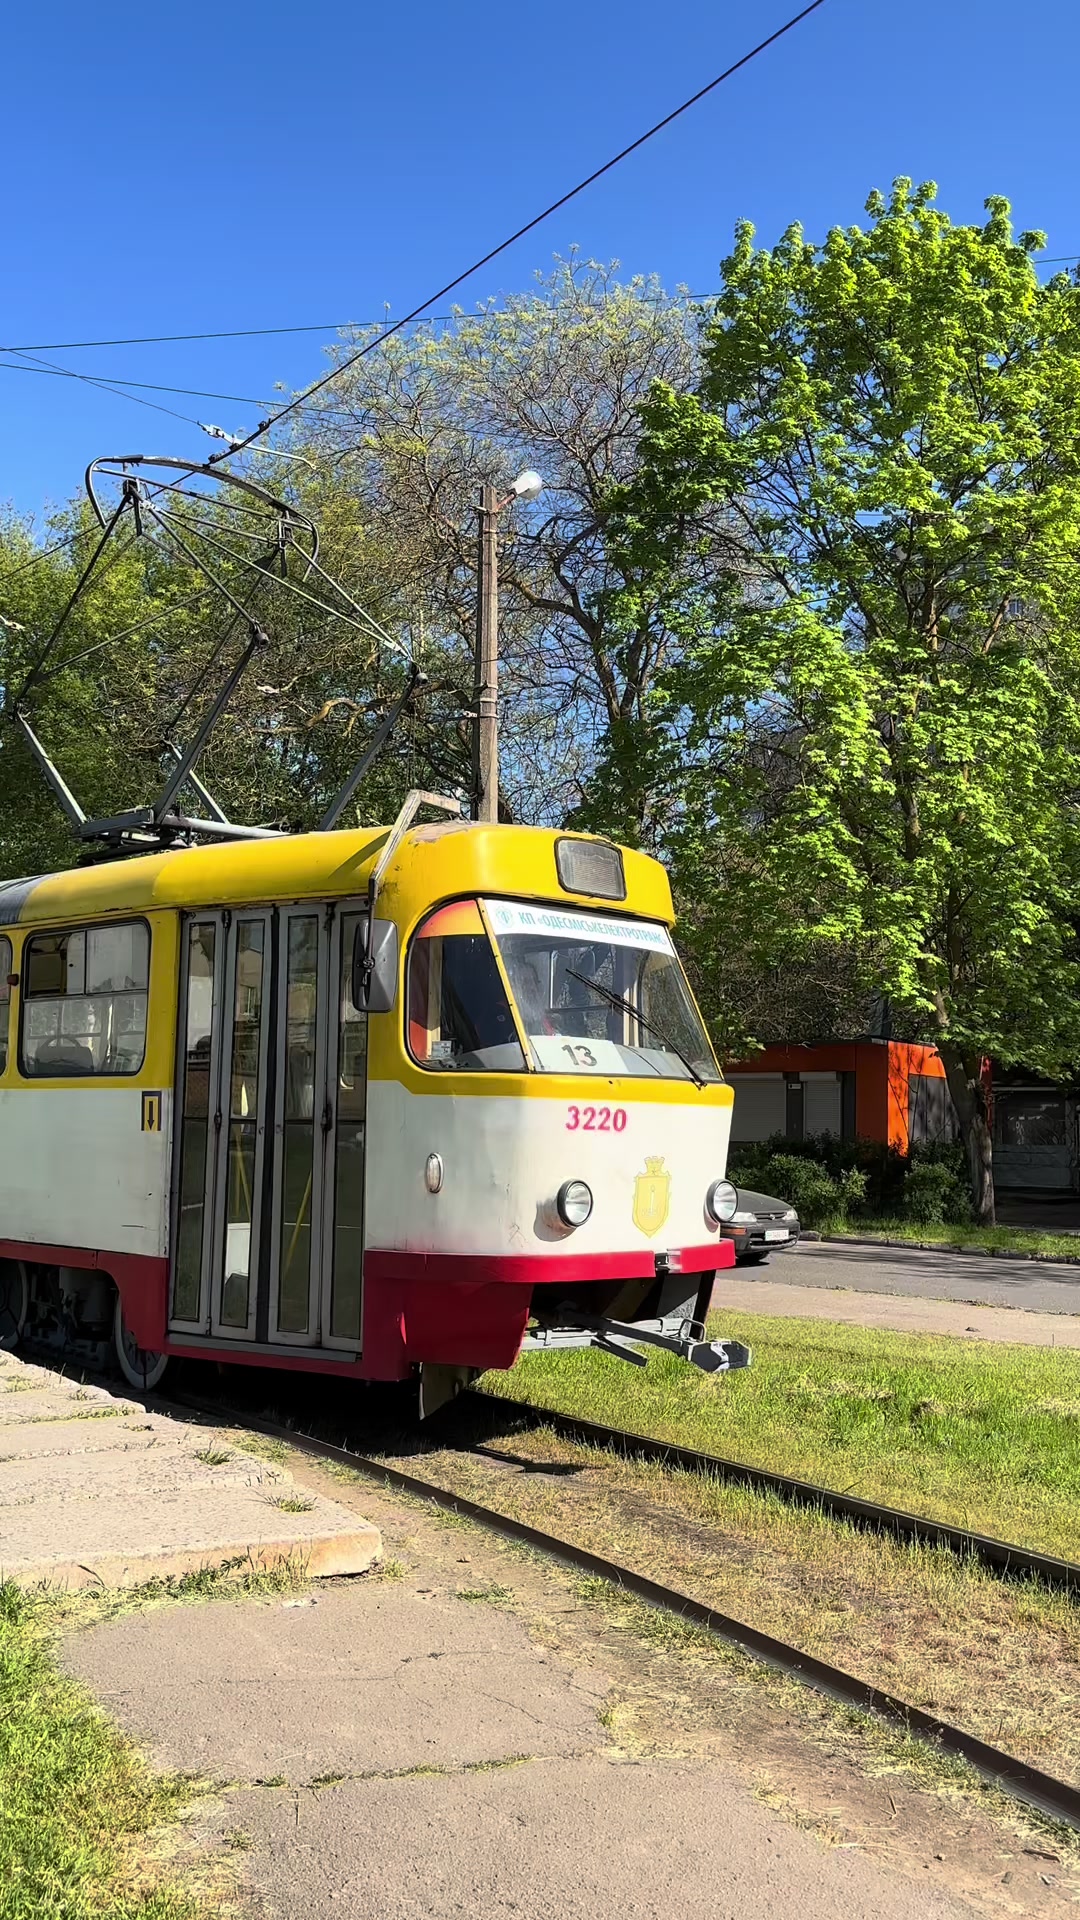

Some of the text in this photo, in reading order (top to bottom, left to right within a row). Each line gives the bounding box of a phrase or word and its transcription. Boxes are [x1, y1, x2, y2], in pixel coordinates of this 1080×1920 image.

[518, 911, 536, 925] КП
[561, 1044, 598, 1067] 13
[565, 1105, 627, 1132] 3220
